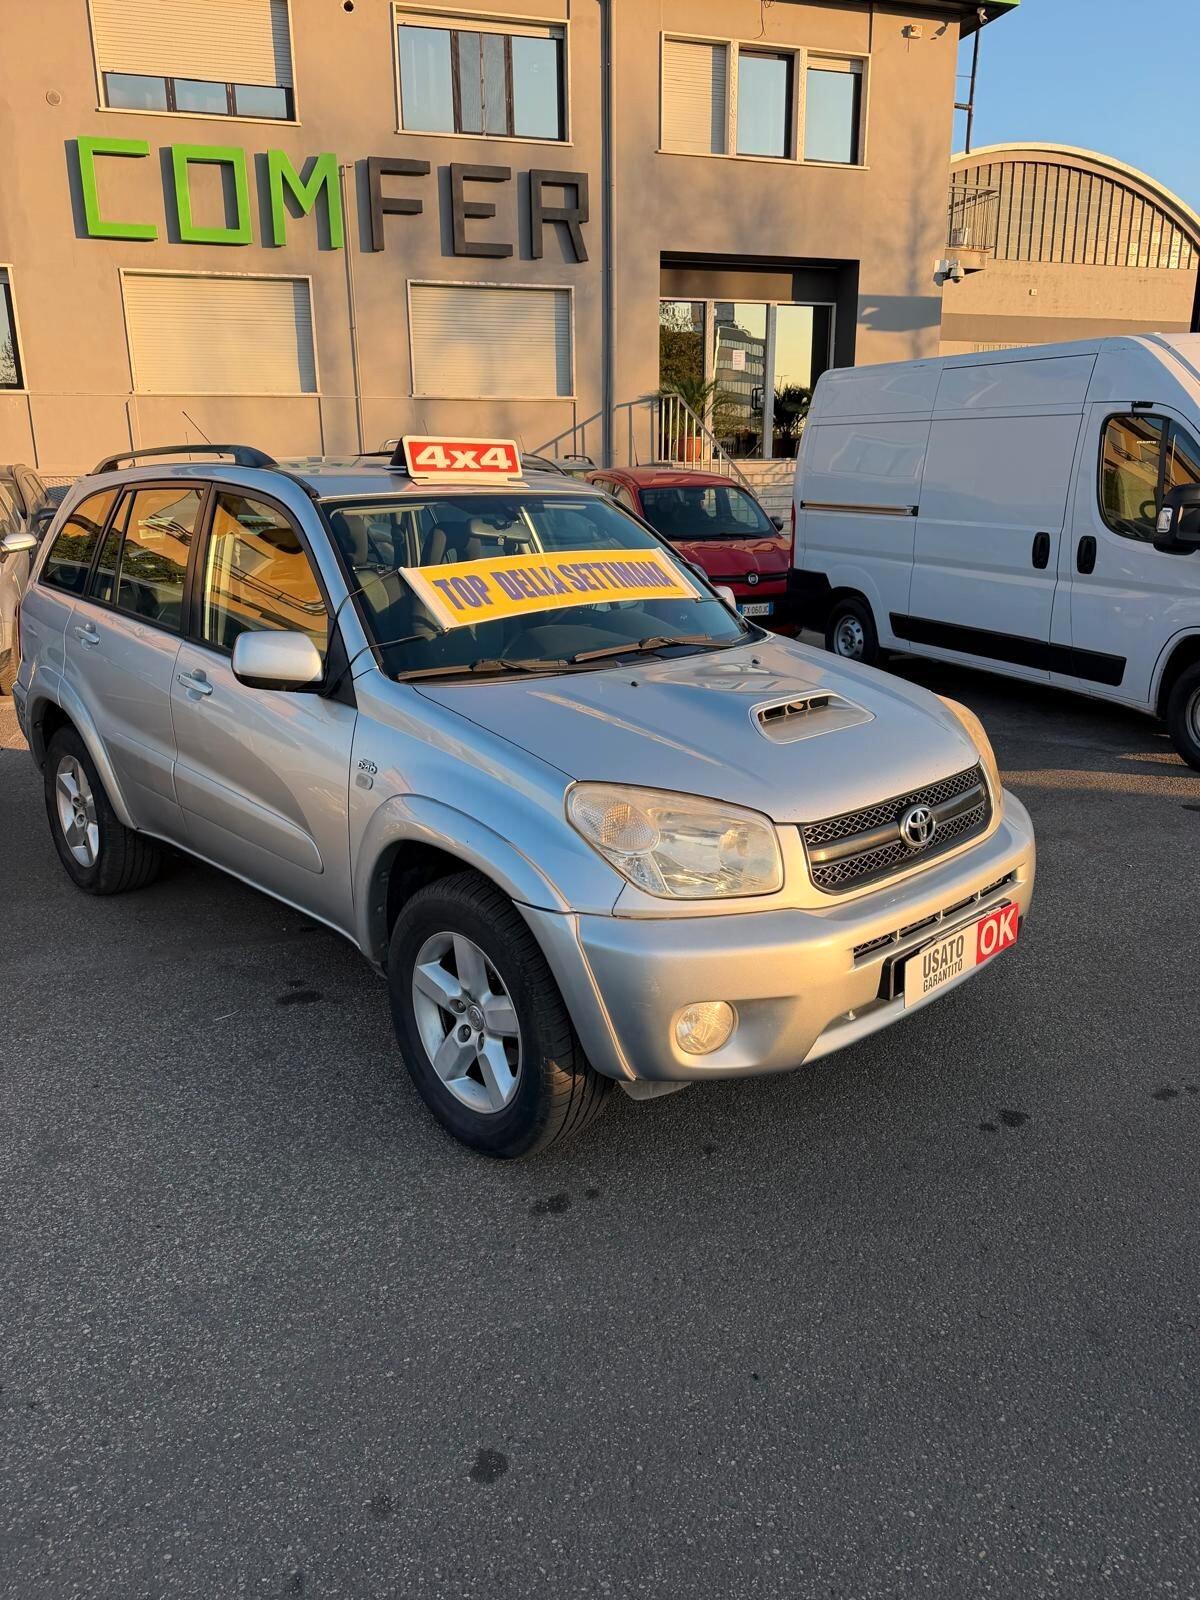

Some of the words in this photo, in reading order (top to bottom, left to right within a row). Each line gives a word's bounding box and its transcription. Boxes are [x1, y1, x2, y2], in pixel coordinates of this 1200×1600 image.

[77, 136, 589, 263] COMFER
[415, 445, 513, 470] 4x4
[432, 574, 494, 610] TOP
[490, 566, 573, 601] DELLA
[556, 561, 678, 591] SETTIMANA
[980, 907, 1016, 955] OK
[922, 935, 965, 979] USATO
[923, 958, 963, 993] GARANTITO
